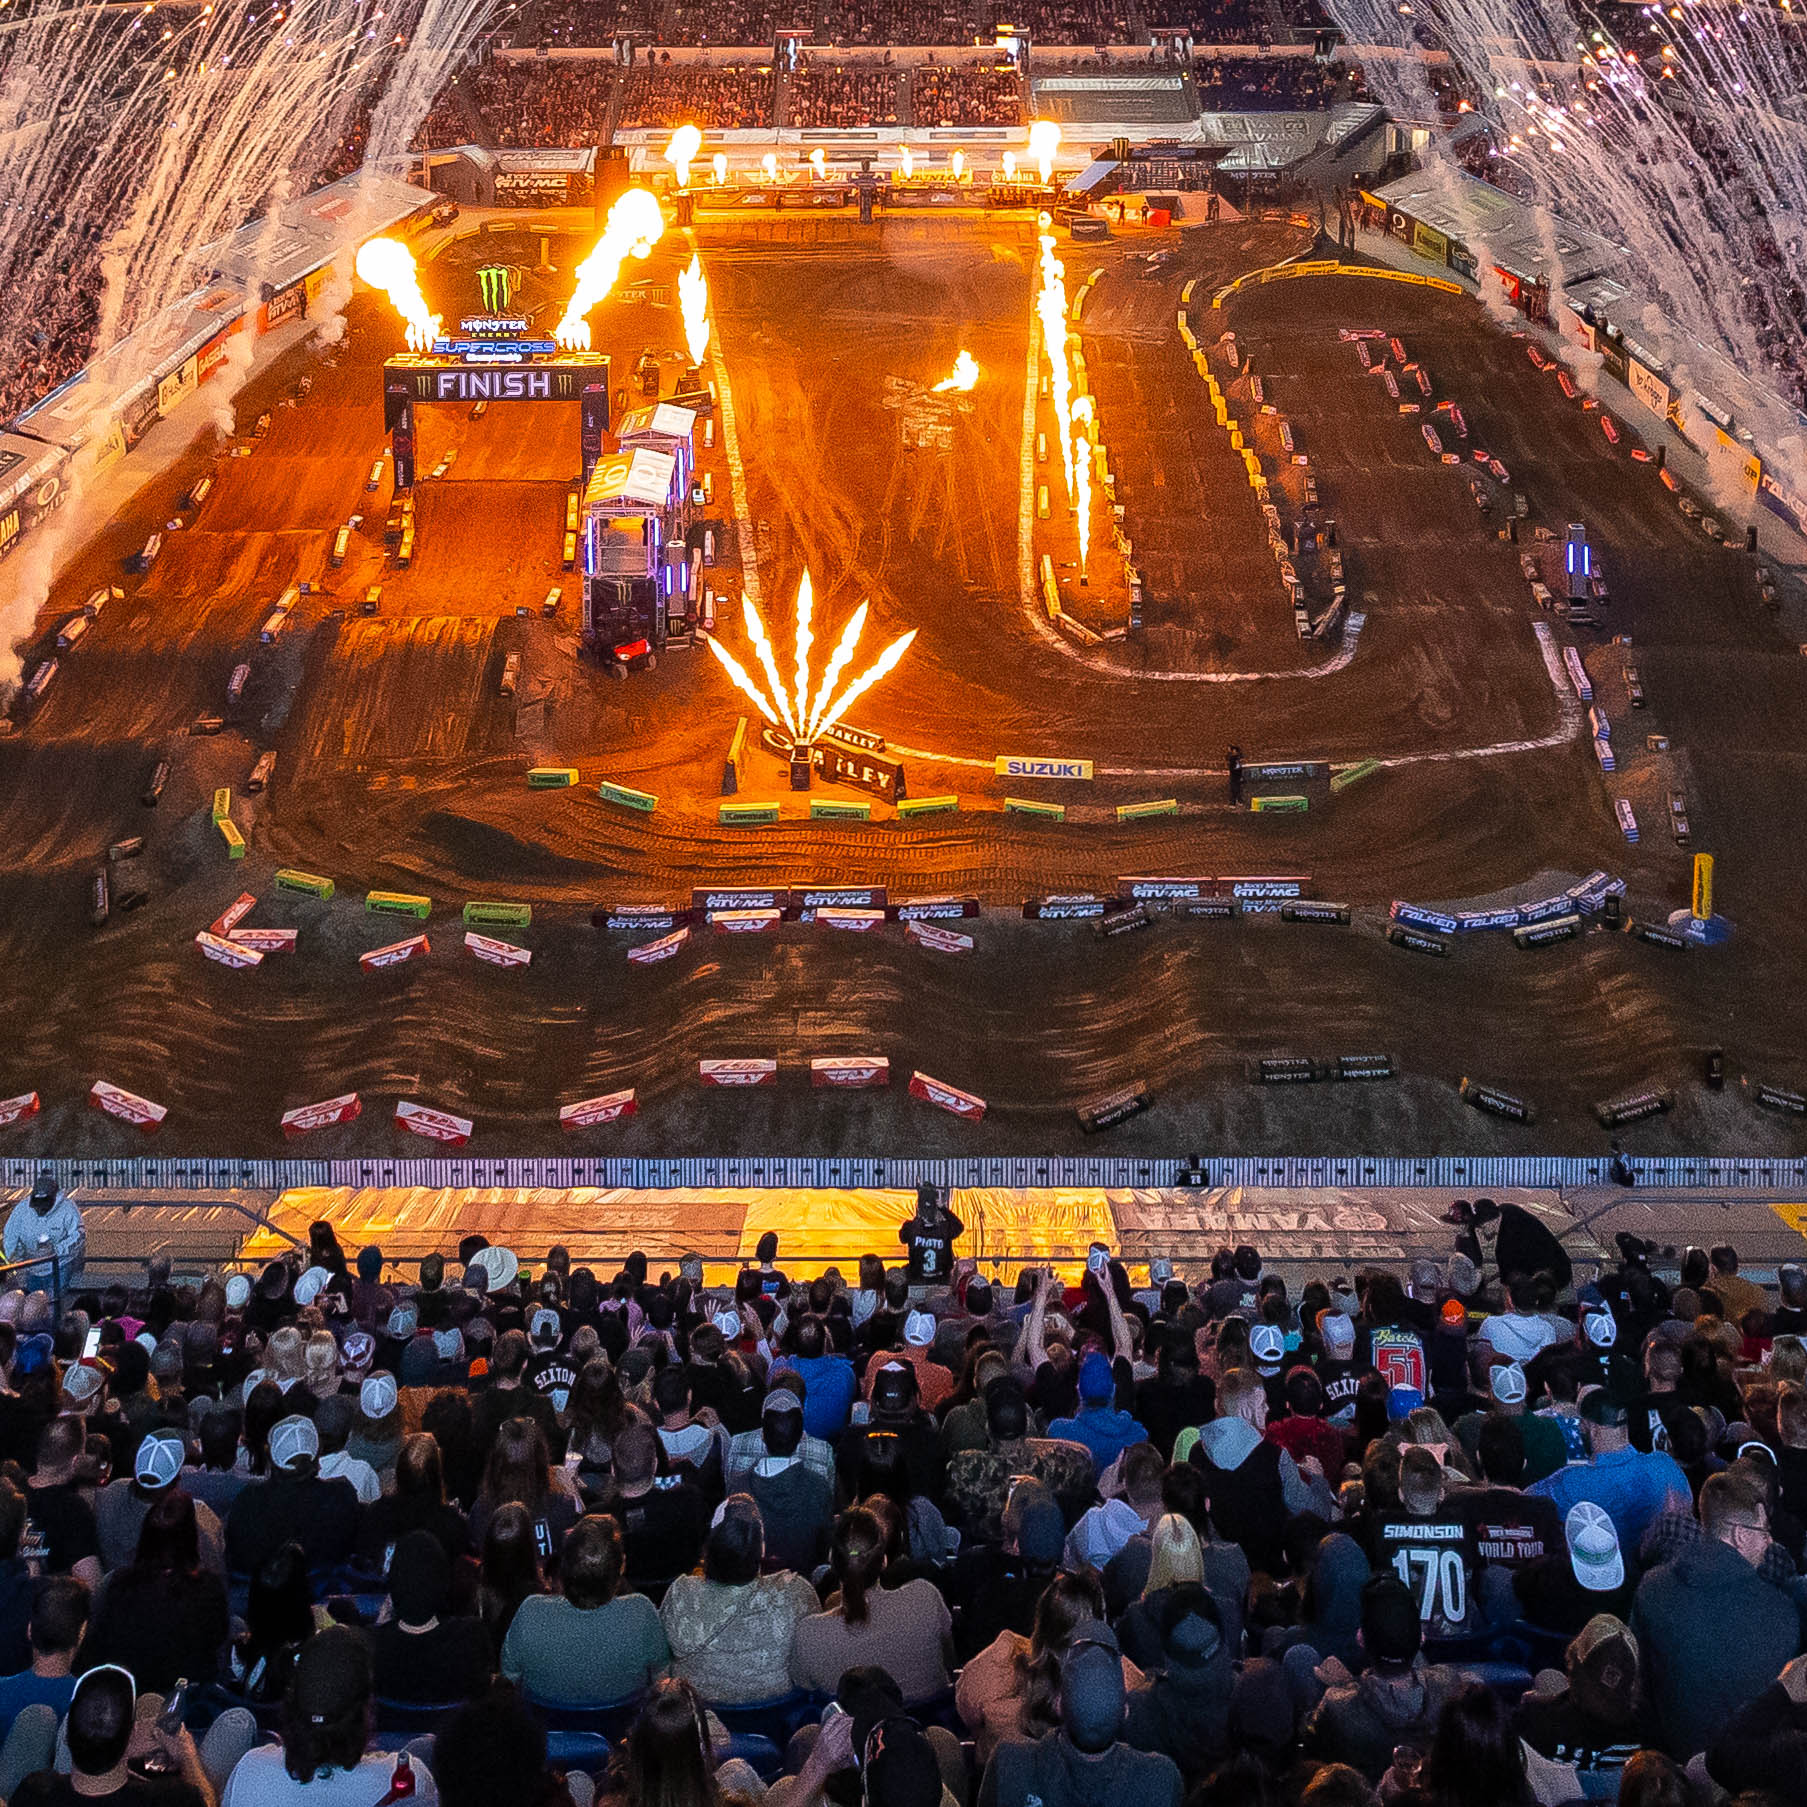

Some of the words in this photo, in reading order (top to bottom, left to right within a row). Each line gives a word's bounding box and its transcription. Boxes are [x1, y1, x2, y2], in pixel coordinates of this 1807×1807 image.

[461, 320, 528, 332] MONSTER
[433, 342, 556, 353] SUPERCROSS
[438, 372, 551, 398] FINISH
[1008, 761, 1083, 777] SUZUKI
[726, 811, 772, 821] Kawasaki
[816, 808, 864, 819] Kawasaki
[1527, 900, 1572, 921] FALKEN
[1400, 909, 1457, 931] FALKEN
[1464, 913, 1519, 929] FALKEN
[1529, 926, 1571, 942] MONSTER
[923, 1248, 937, 1272] 3
[1378, 1346, 1426, 1388] 51
[535, 1369, 576, 1390] SEXTON
[1383, 1524, 1464, 1540] SIMONSON
[1478, 1542, 1515, 1560] WORLD
[1517, 1541, 1544, 1558] TOUR
[1391, 1546, 1465, 1624] 170
